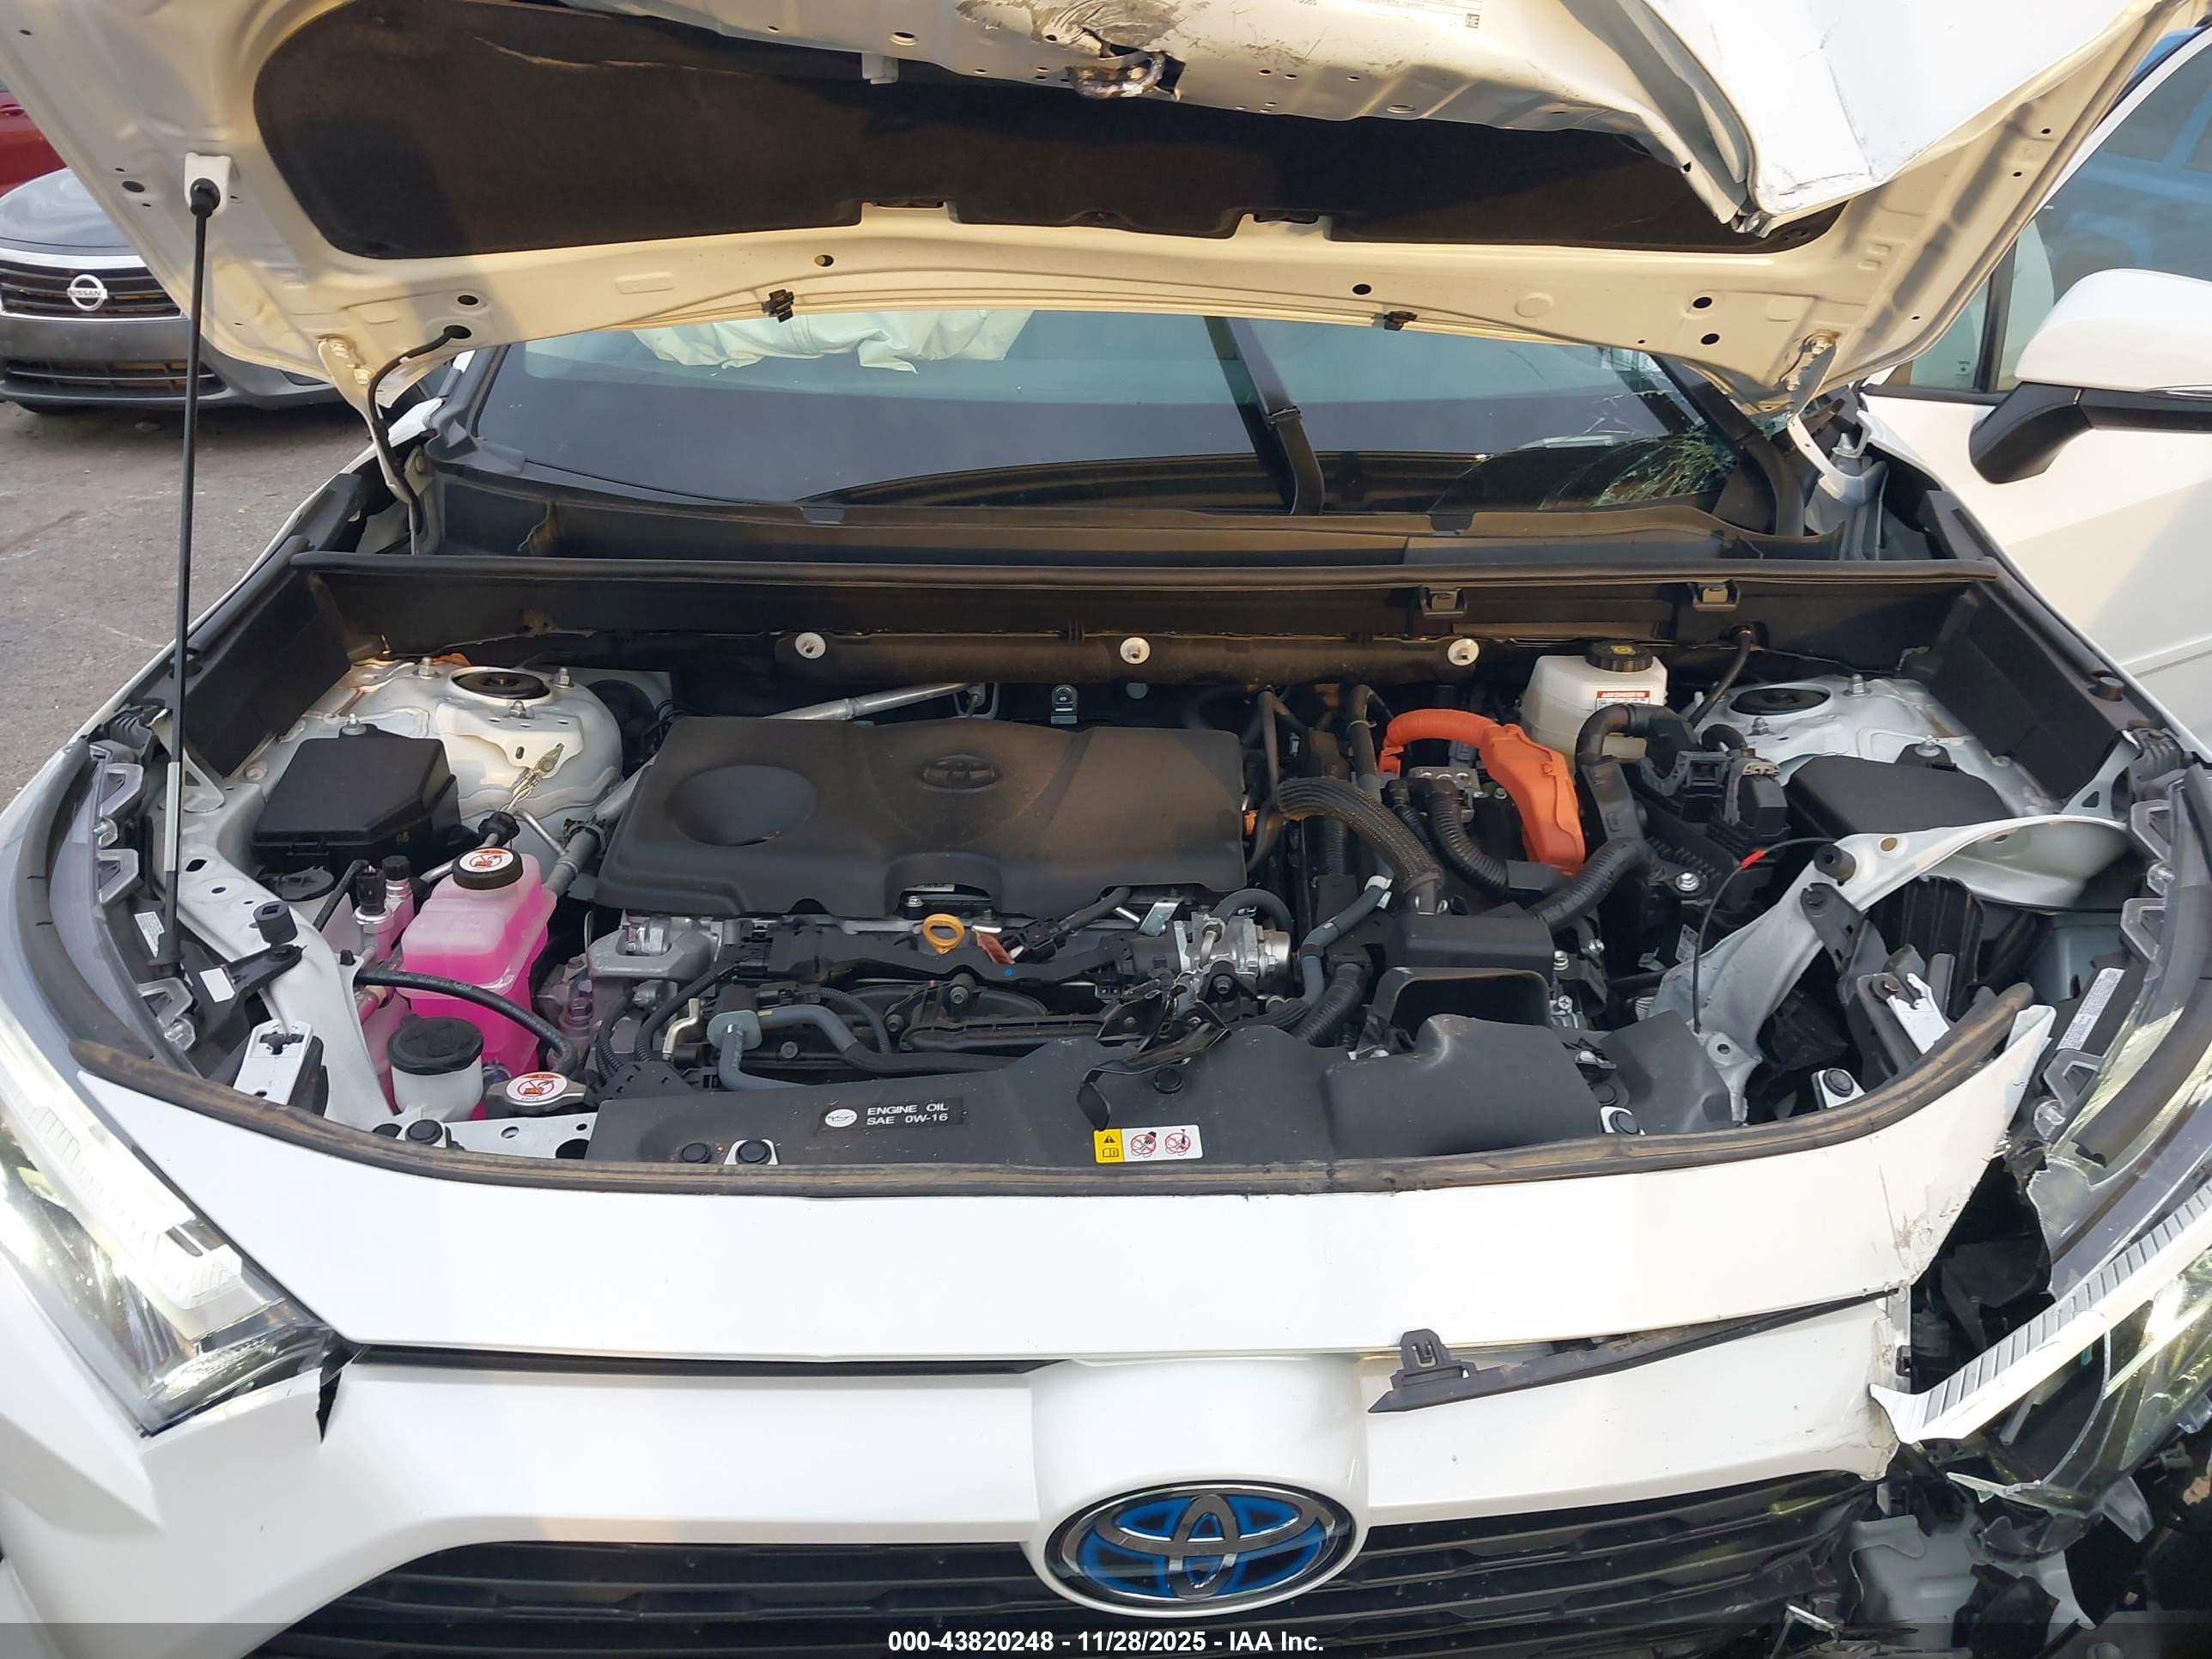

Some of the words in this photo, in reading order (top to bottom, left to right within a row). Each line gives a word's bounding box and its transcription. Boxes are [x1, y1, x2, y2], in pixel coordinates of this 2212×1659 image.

[867, 1104, 918, 1115] ENGINE
[926, 1103, 949, 1112] OIL
[866, 1115, 895, 1126] SAE
[904, 1114, 949, 1124] 0W-16
